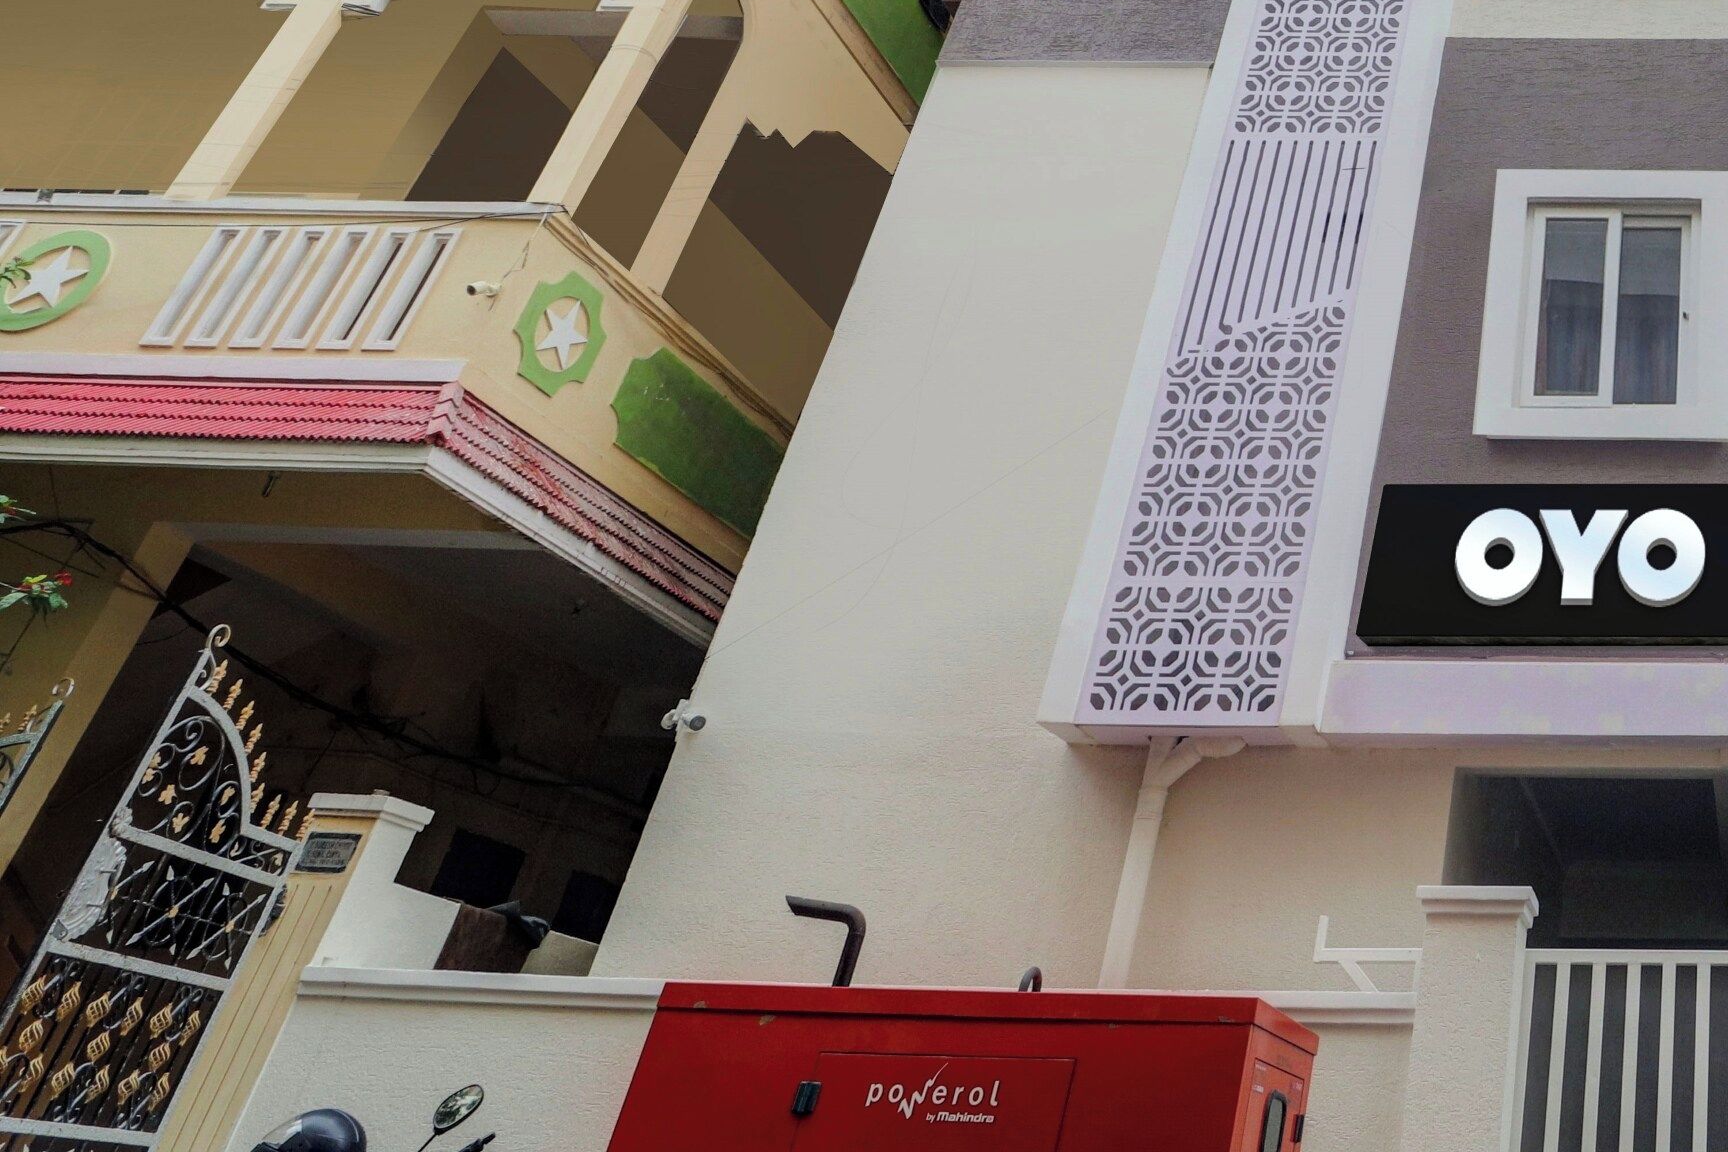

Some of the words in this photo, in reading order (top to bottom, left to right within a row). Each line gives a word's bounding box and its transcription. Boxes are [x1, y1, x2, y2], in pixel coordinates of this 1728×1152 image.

[1455, 507, 1706, 608] OYO
[865, 1062, 1000, 1119] powerol
[926, 1112, 936, 1123] by
[936, 1111, 995, 1123] Mahindra
